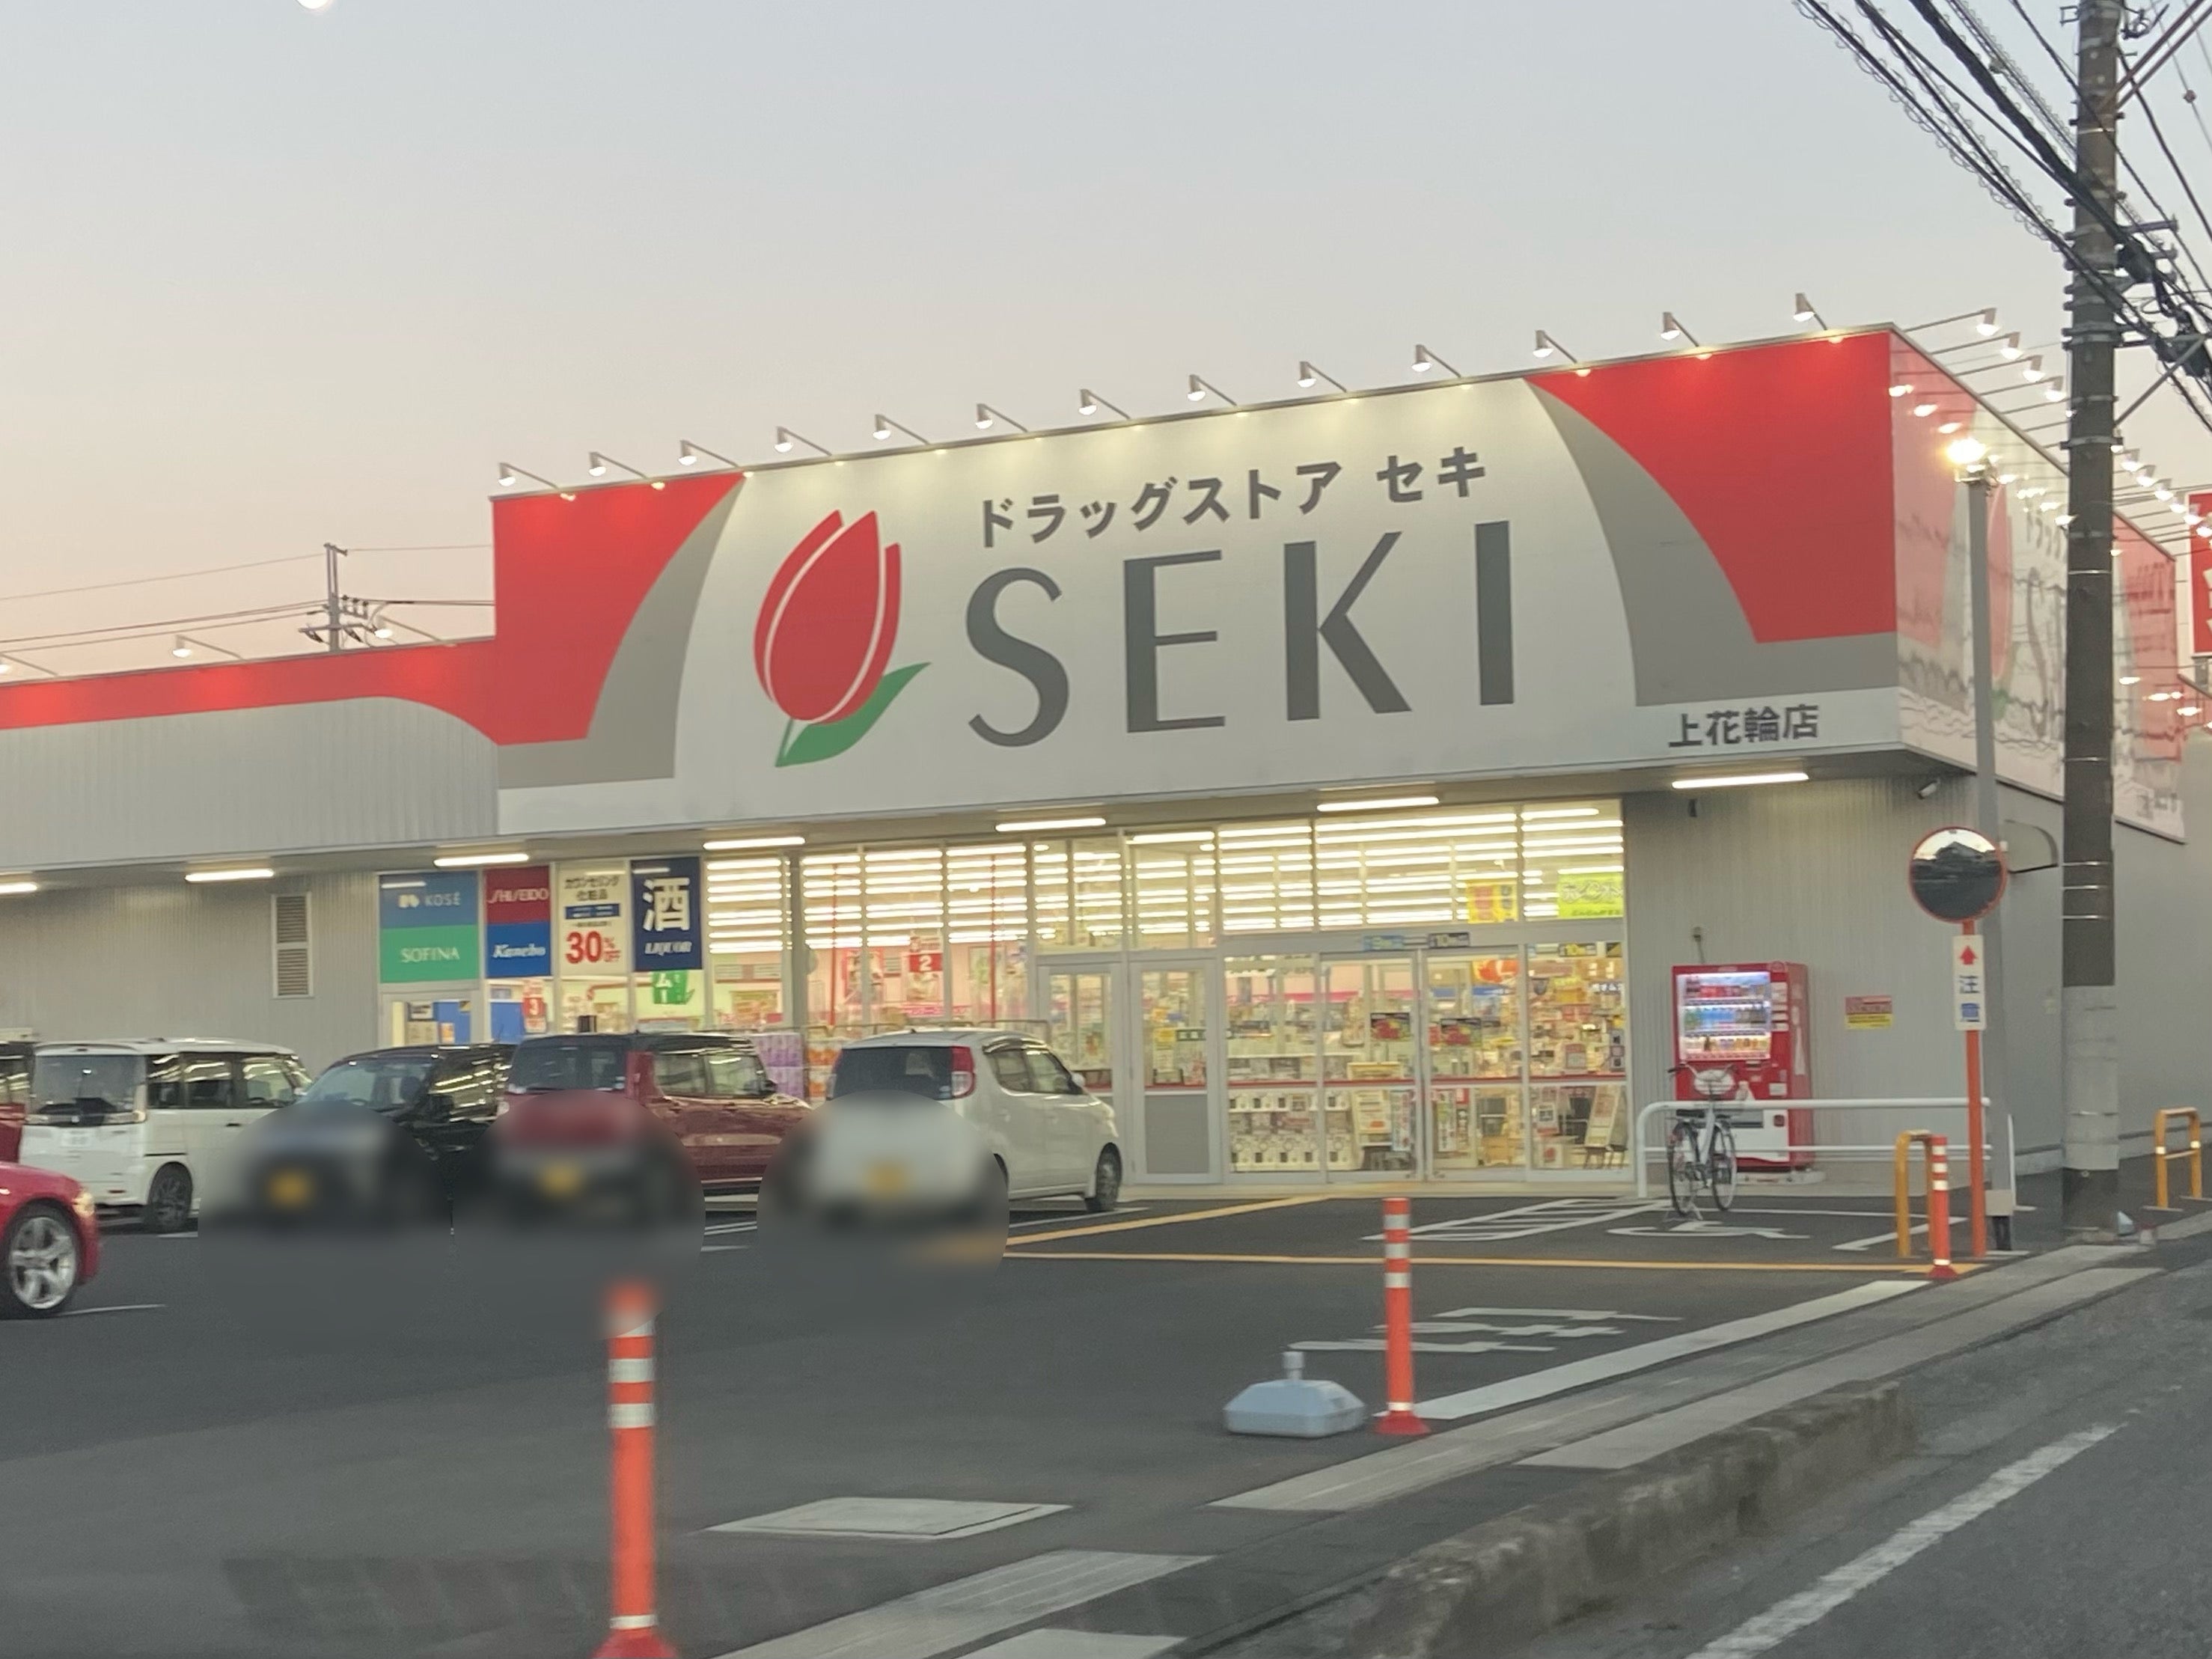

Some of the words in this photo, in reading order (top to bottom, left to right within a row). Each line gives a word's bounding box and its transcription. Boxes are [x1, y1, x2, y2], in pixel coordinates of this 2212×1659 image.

[982, 461, 1342, 549] ドラッグストア
[1377, 447, 1486, 502] セキ
[965, 520, 1515, 748] SEKI
[1668, 704, 1819, 748] 上花輪店
[643, 877, 690, 931] 酒
[401, 947, 460, 963] SOFINA
